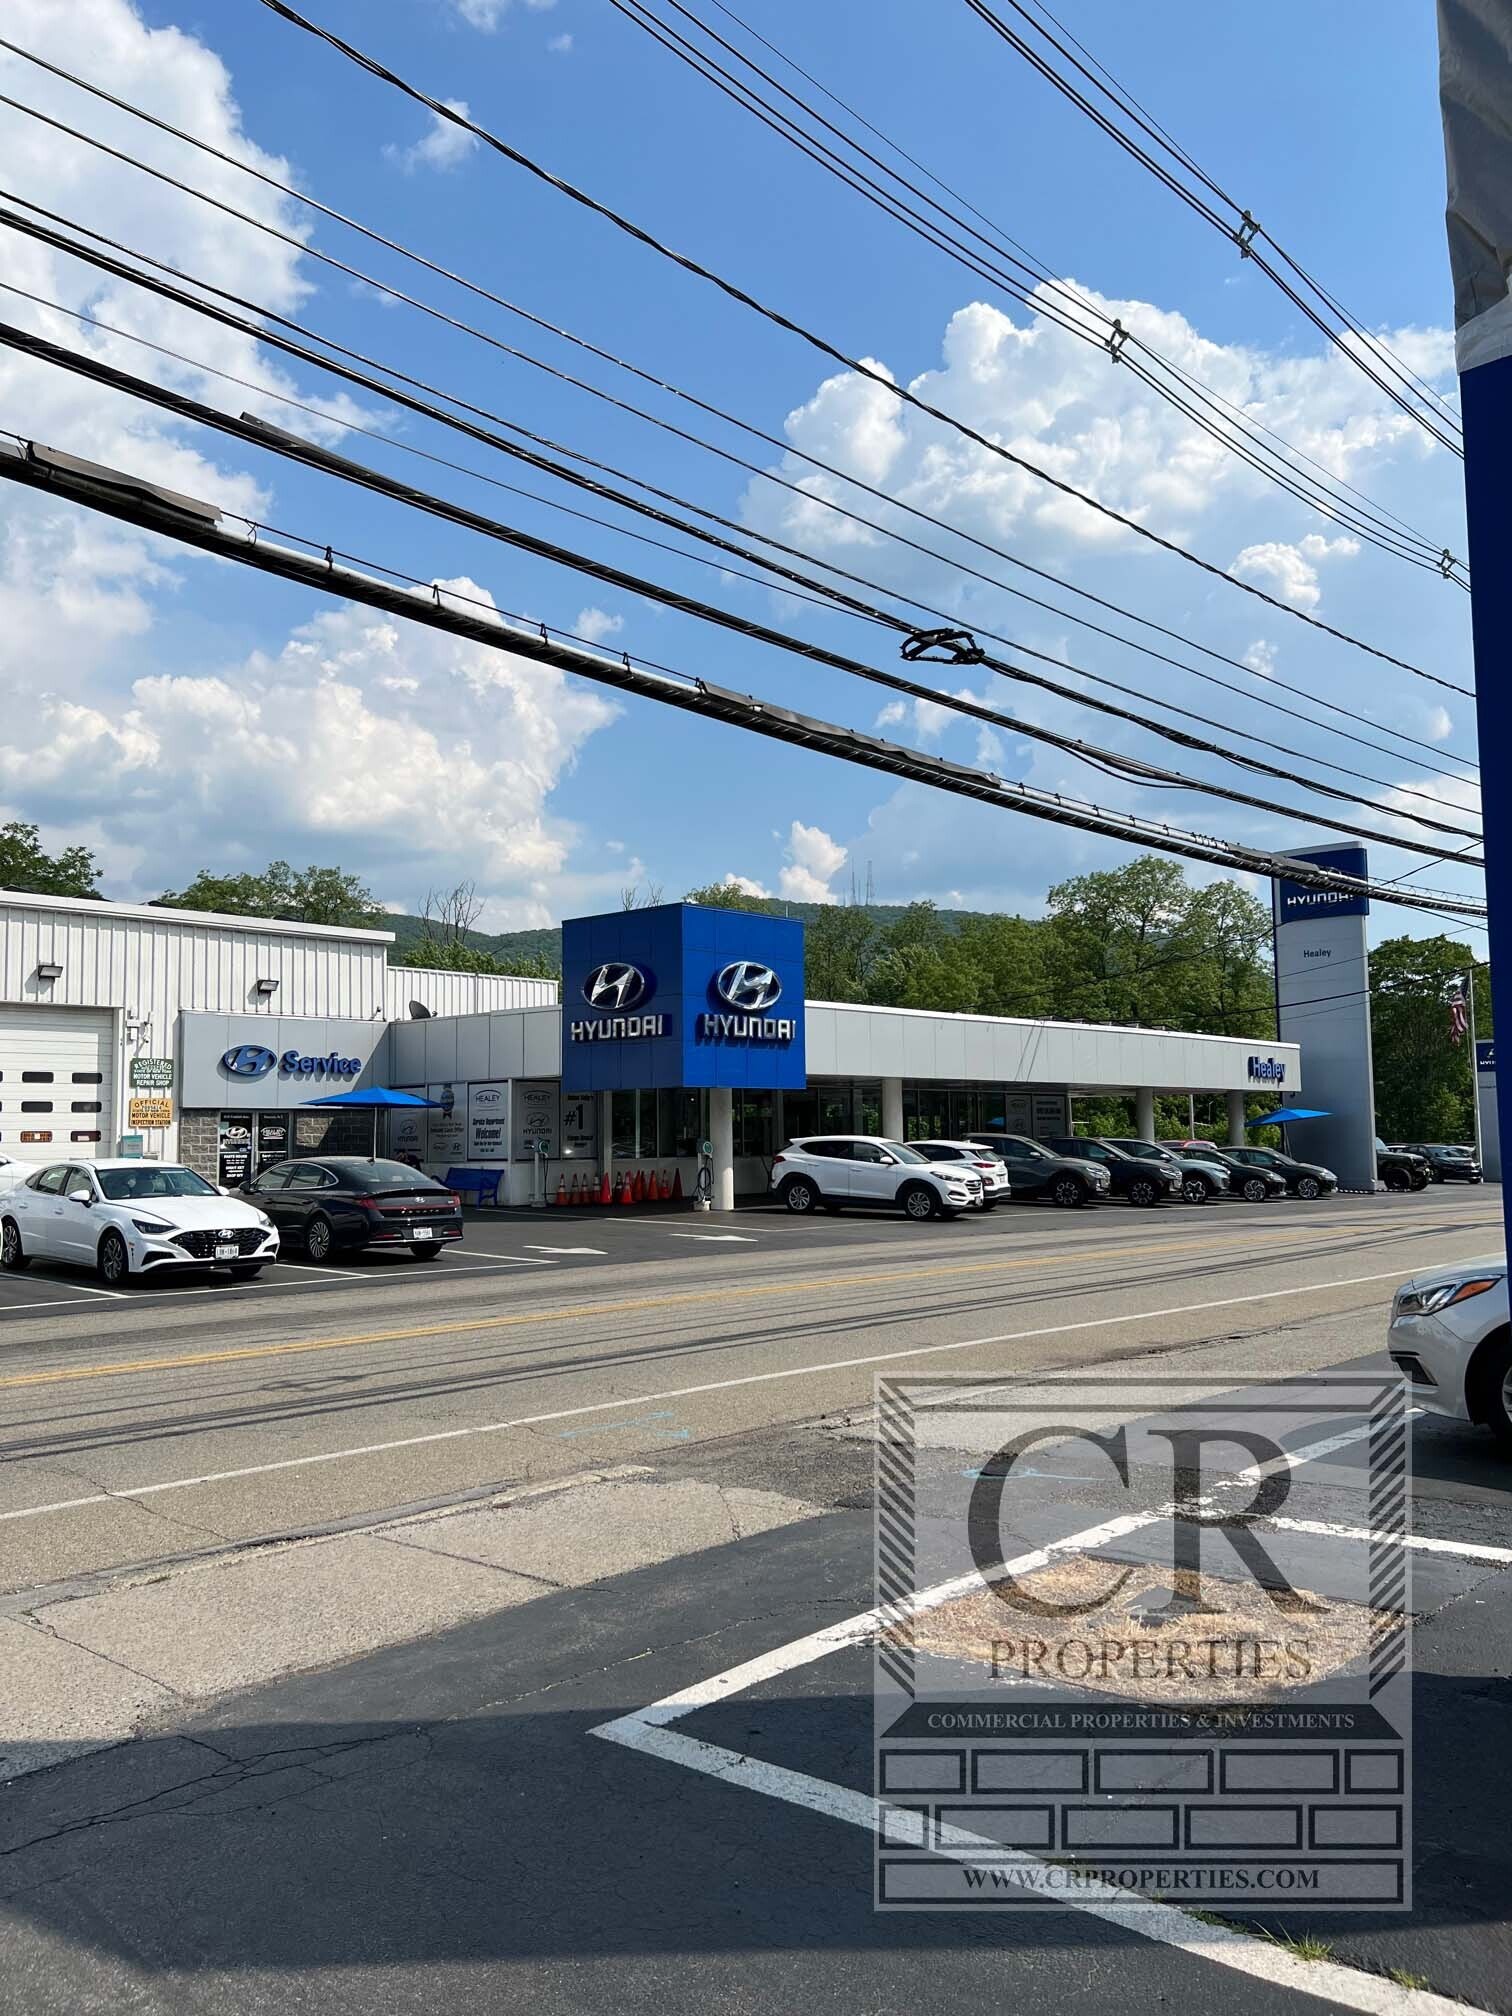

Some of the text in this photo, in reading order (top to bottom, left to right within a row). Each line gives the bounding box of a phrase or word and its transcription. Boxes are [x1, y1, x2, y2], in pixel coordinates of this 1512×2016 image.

[1303, 948, 1332, 958] Healey
[571, 1015, 663, 1041] HYUNDAI
[704, 1013, 796, 1040] HYUNDAI
[134, 1058, 172, 1070] REGISTERED
[282, 1050, 361, 1074] Service
[1249, 1056, 1287, 1083] Healey
[134, 1099, 169, 1108] OFFICIAL
[475, 1095, 500, 1103] HEALEY
[563, 1103, 584, 1130] #1
